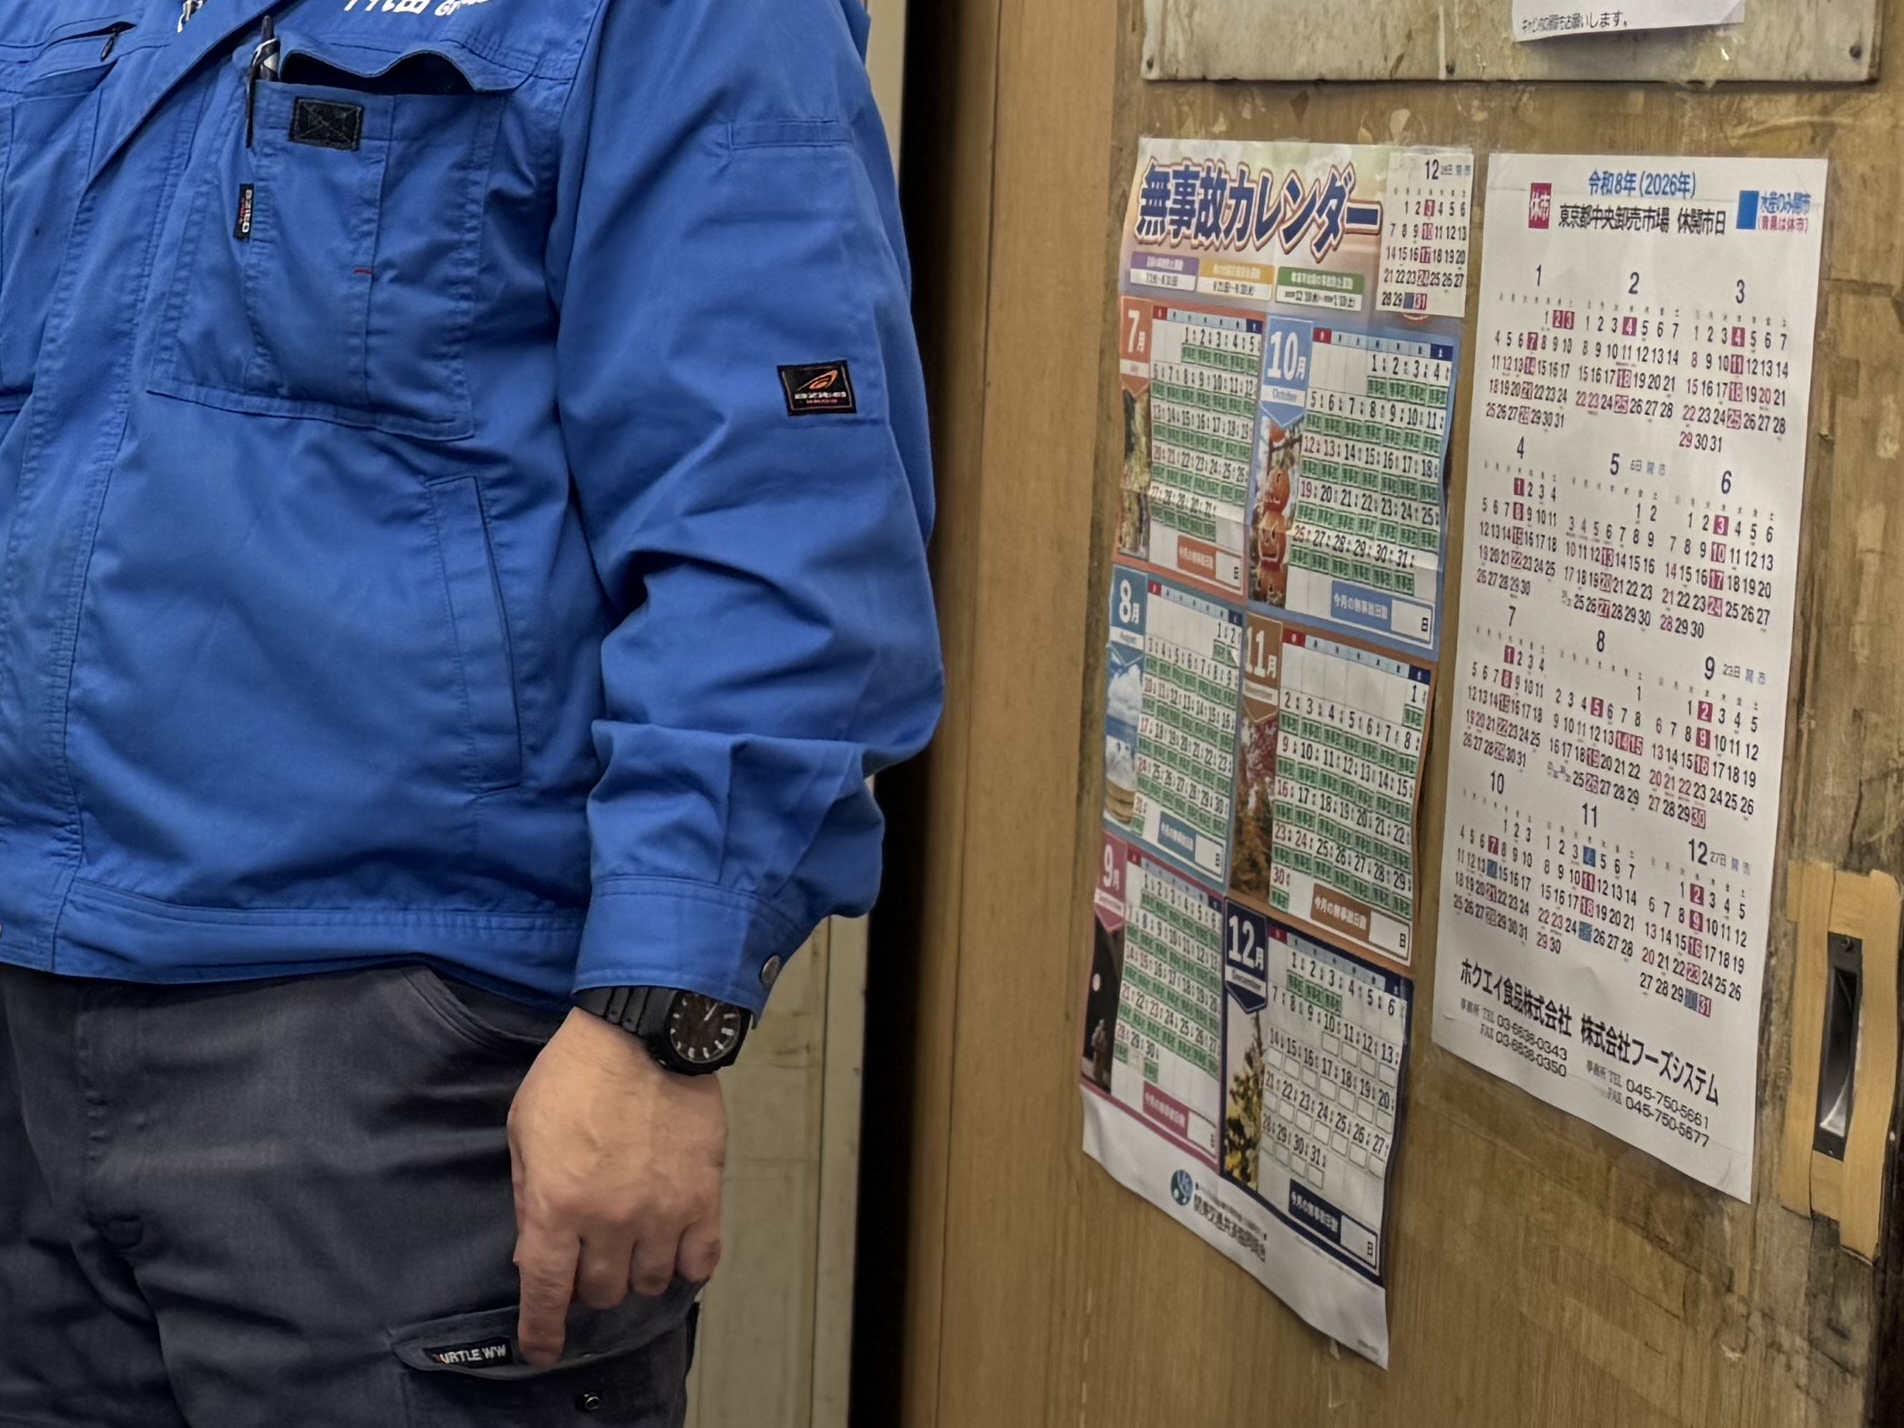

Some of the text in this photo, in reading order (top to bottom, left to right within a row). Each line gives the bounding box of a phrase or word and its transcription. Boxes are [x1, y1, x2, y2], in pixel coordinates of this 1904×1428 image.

[1424, 158, 1440, 181] 12
[1588, 170, 1697, 199] 令和8年(2026年)
[1135, 160, 1382, 262] 無事故カレンダー
[1558, 204, 1671, 234] 東京都中央卸売市場
[1628, 272, 1640, 294] 2
[1736, 279, 1745, 304] 3
[1127, 309, 1145, 353] 7月
[1268, 331, 1306, 381] 10月
[1516, 436, 1526, 460] 4
[1610, 454, 1620, 475] 5
[1721, 470, 1732, 494] 6
[1119, 579, 1140, 624] 8月
[1508, 606, 1517, 628] 7
[1596, 630, 1606, 652] 8
[1704, 656, 1716, 680] 9
[1490, 771, 1505, 794] 10
[1582, 804, 1598, 828] 11
[1103, 842, 1121, 888] 9月
[1688, 838, 1708, 866] 12
[1227, 914, 1265, 964] 12月
[1460, 958, 1573, 1039] ホクエイ食品株式会社
[1580, 1011, 1720, 1107] 株式会社フーズシステム
